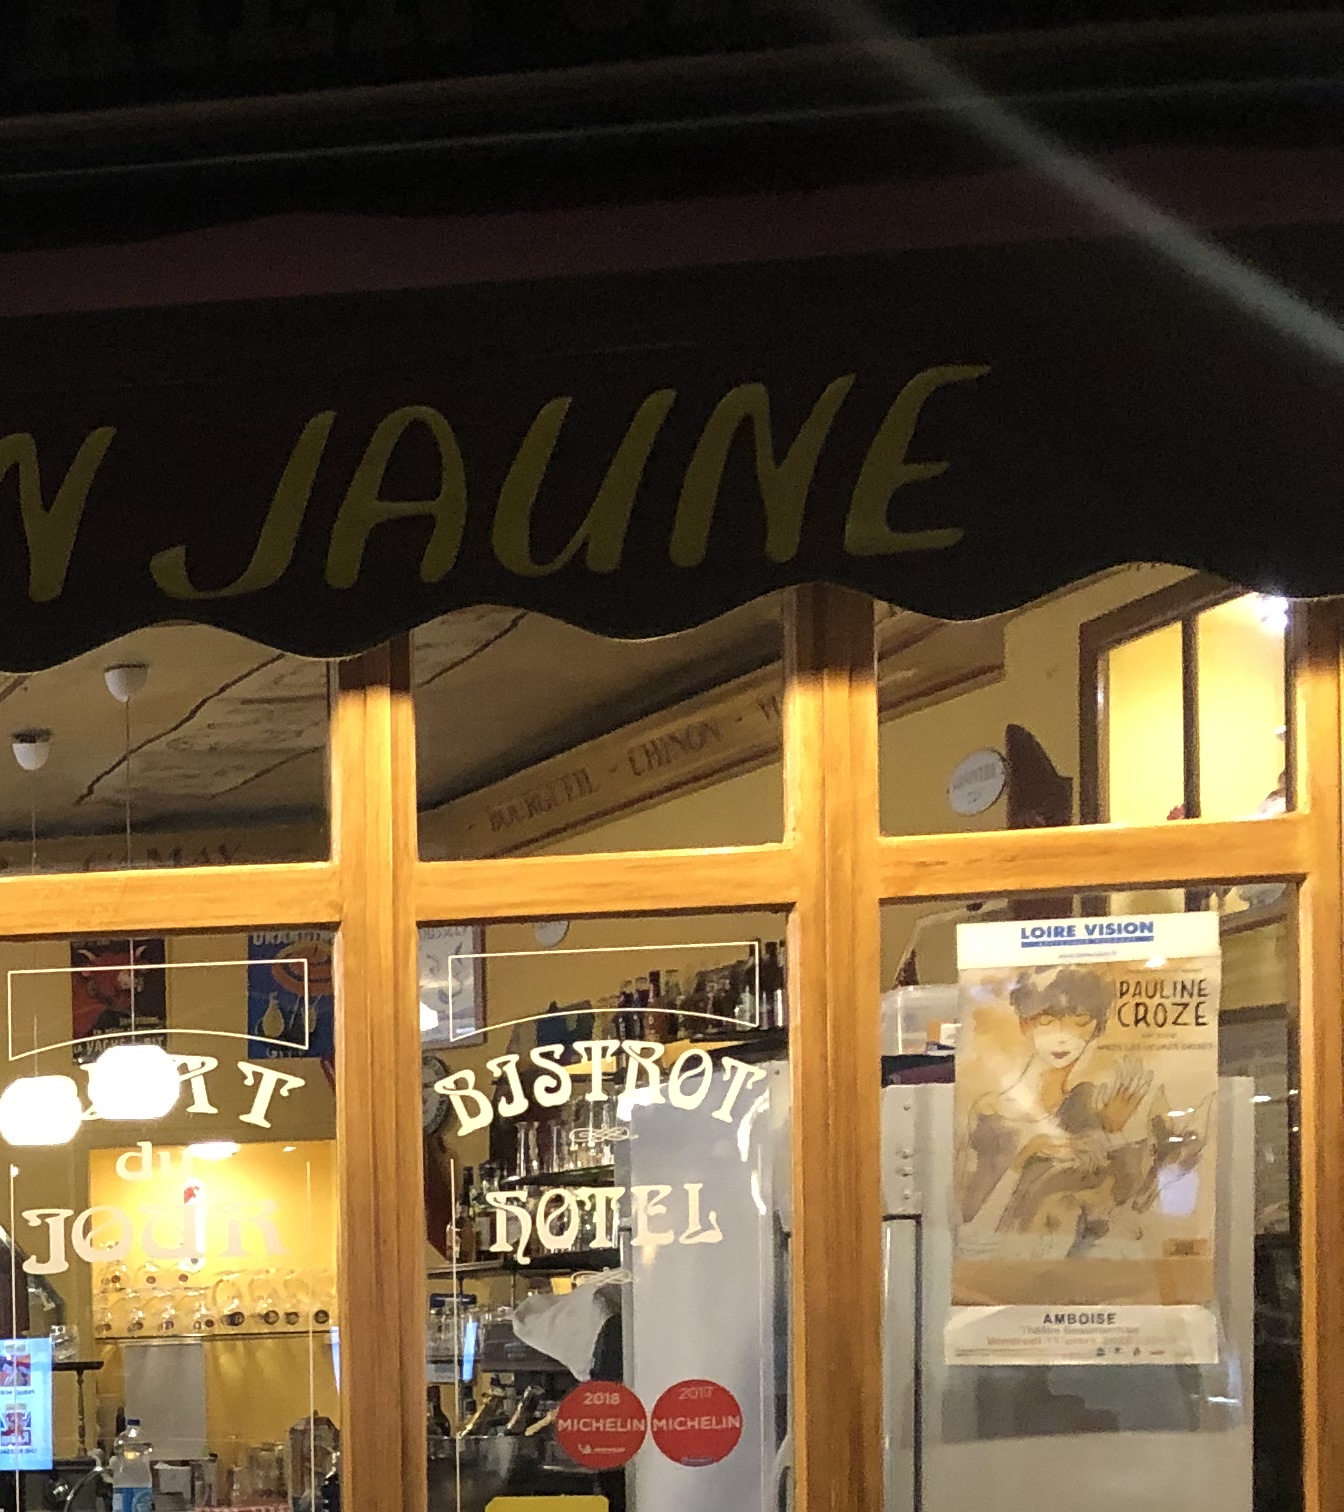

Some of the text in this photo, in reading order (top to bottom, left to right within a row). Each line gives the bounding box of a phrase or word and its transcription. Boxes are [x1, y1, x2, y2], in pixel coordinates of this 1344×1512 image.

[149, 364, 992, 600] JAUNE
[1021, 921, 1154, 940] LOIRE VISION
[1119, 977, 1210, 999] PAULINE
[1117, 1001, 1210, 1029] CROZE
[434, 1039, 767, 1137] BISTROT
[485, 1183, 723, 1266] HOTEL
[22, 1201, 289, 1275] JOUR
[1043, 1312, 1118, 1325] AMBOISE
[584, 1392, 621, 1405] 2018
[557, 1418, 646, 1432] MICHELIN
[653, 1415, 741, 1432] MICHELIN
